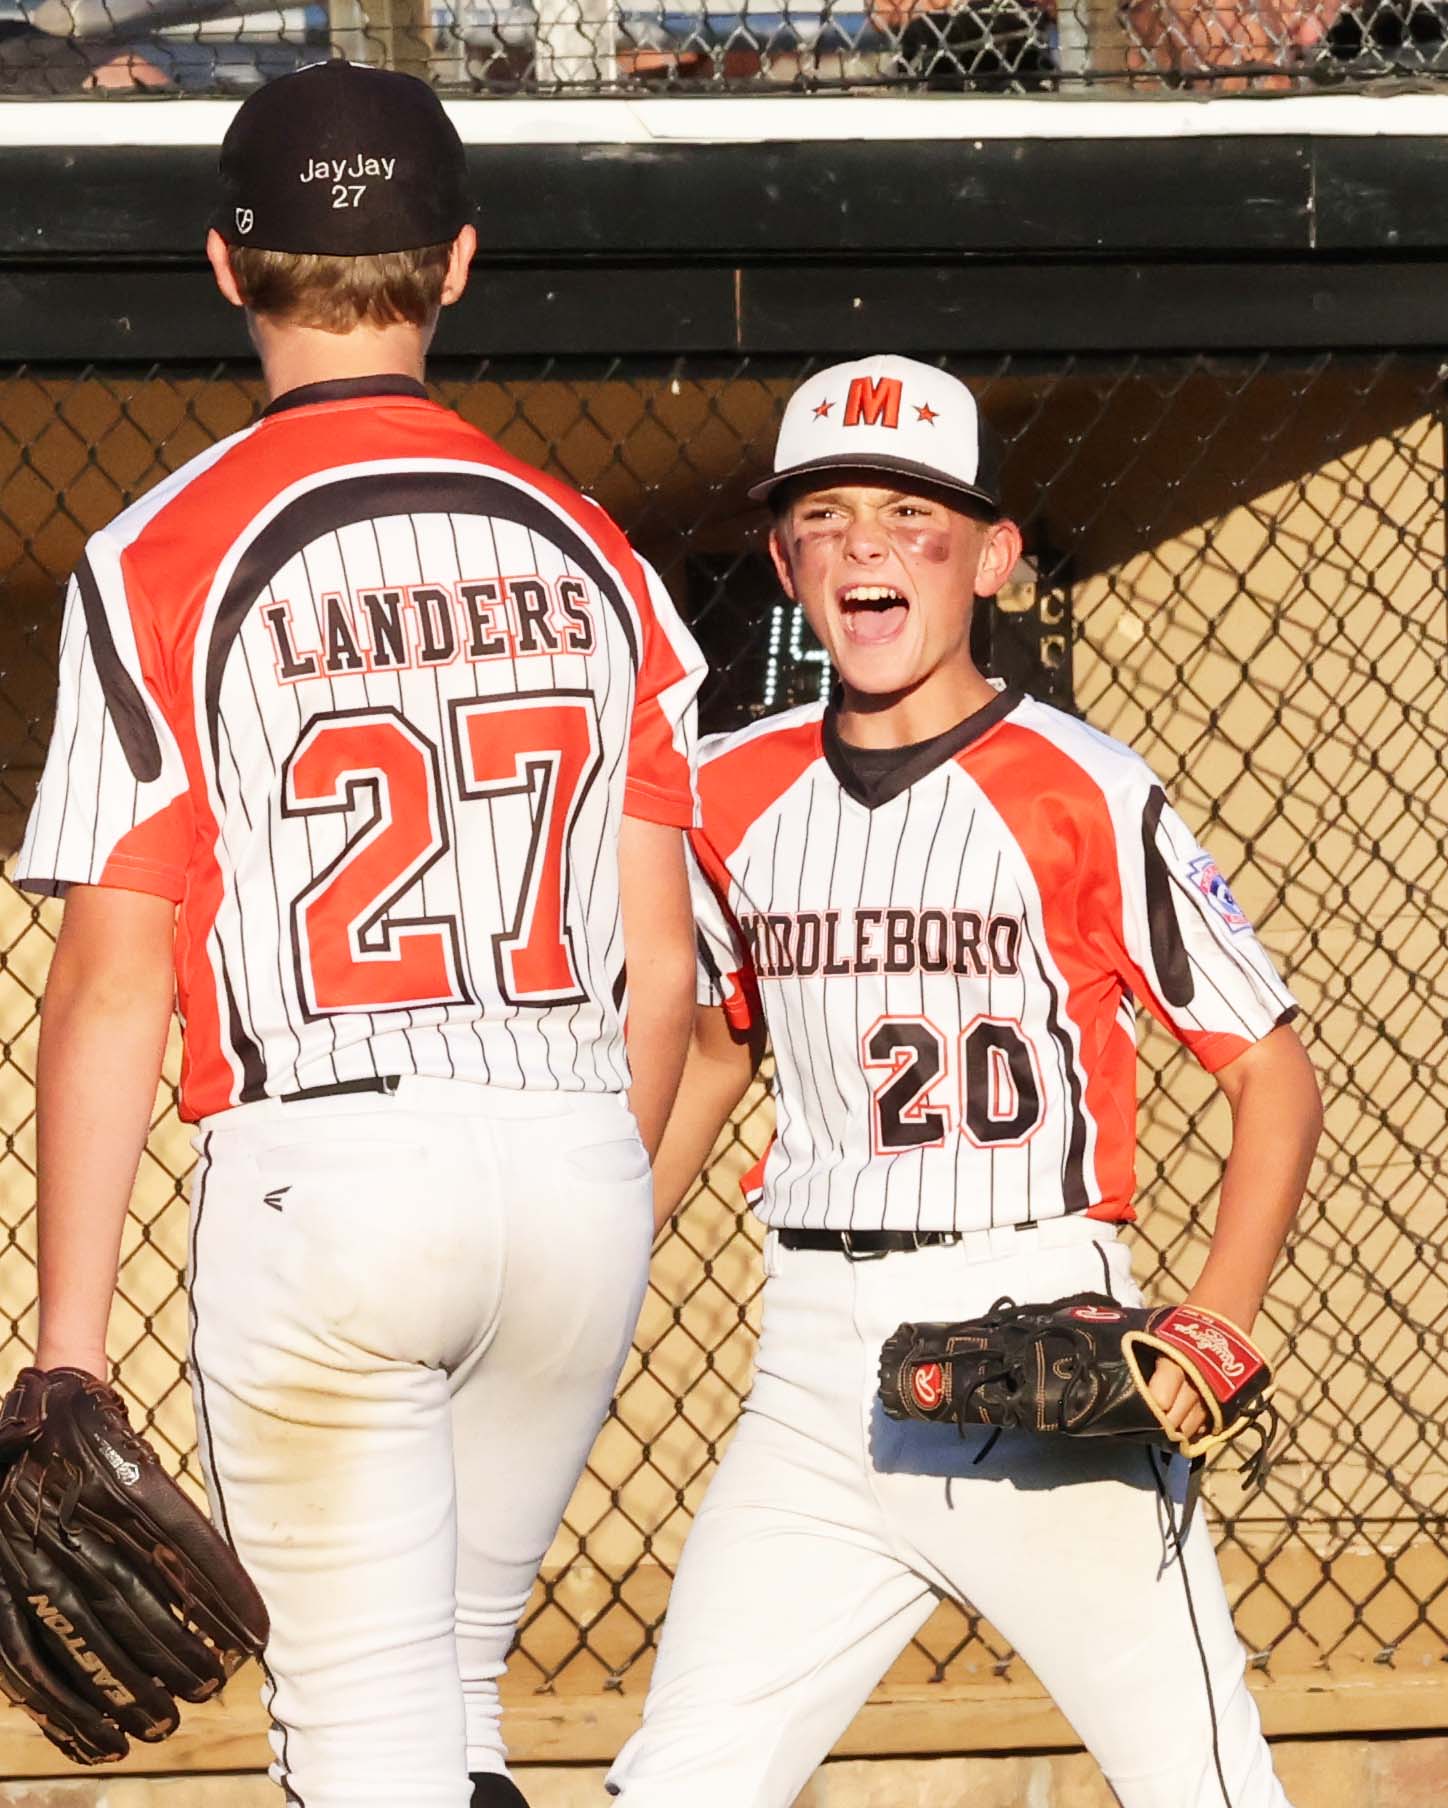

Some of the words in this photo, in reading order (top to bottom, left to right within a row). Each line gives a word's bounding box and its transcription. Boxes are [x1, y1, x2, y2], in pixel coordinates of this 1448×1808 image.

[300, 154, 395, 182] JayJay
[331, 185, 366, 208] 27
[843, 376, 903, 429] M
[260, 576, 597, 686] LANDERS
[281, 689, 604, 1024] 27
[861, 1014, 1047, 1156] 20
[26, 1594, 136, 1706] EASTON
